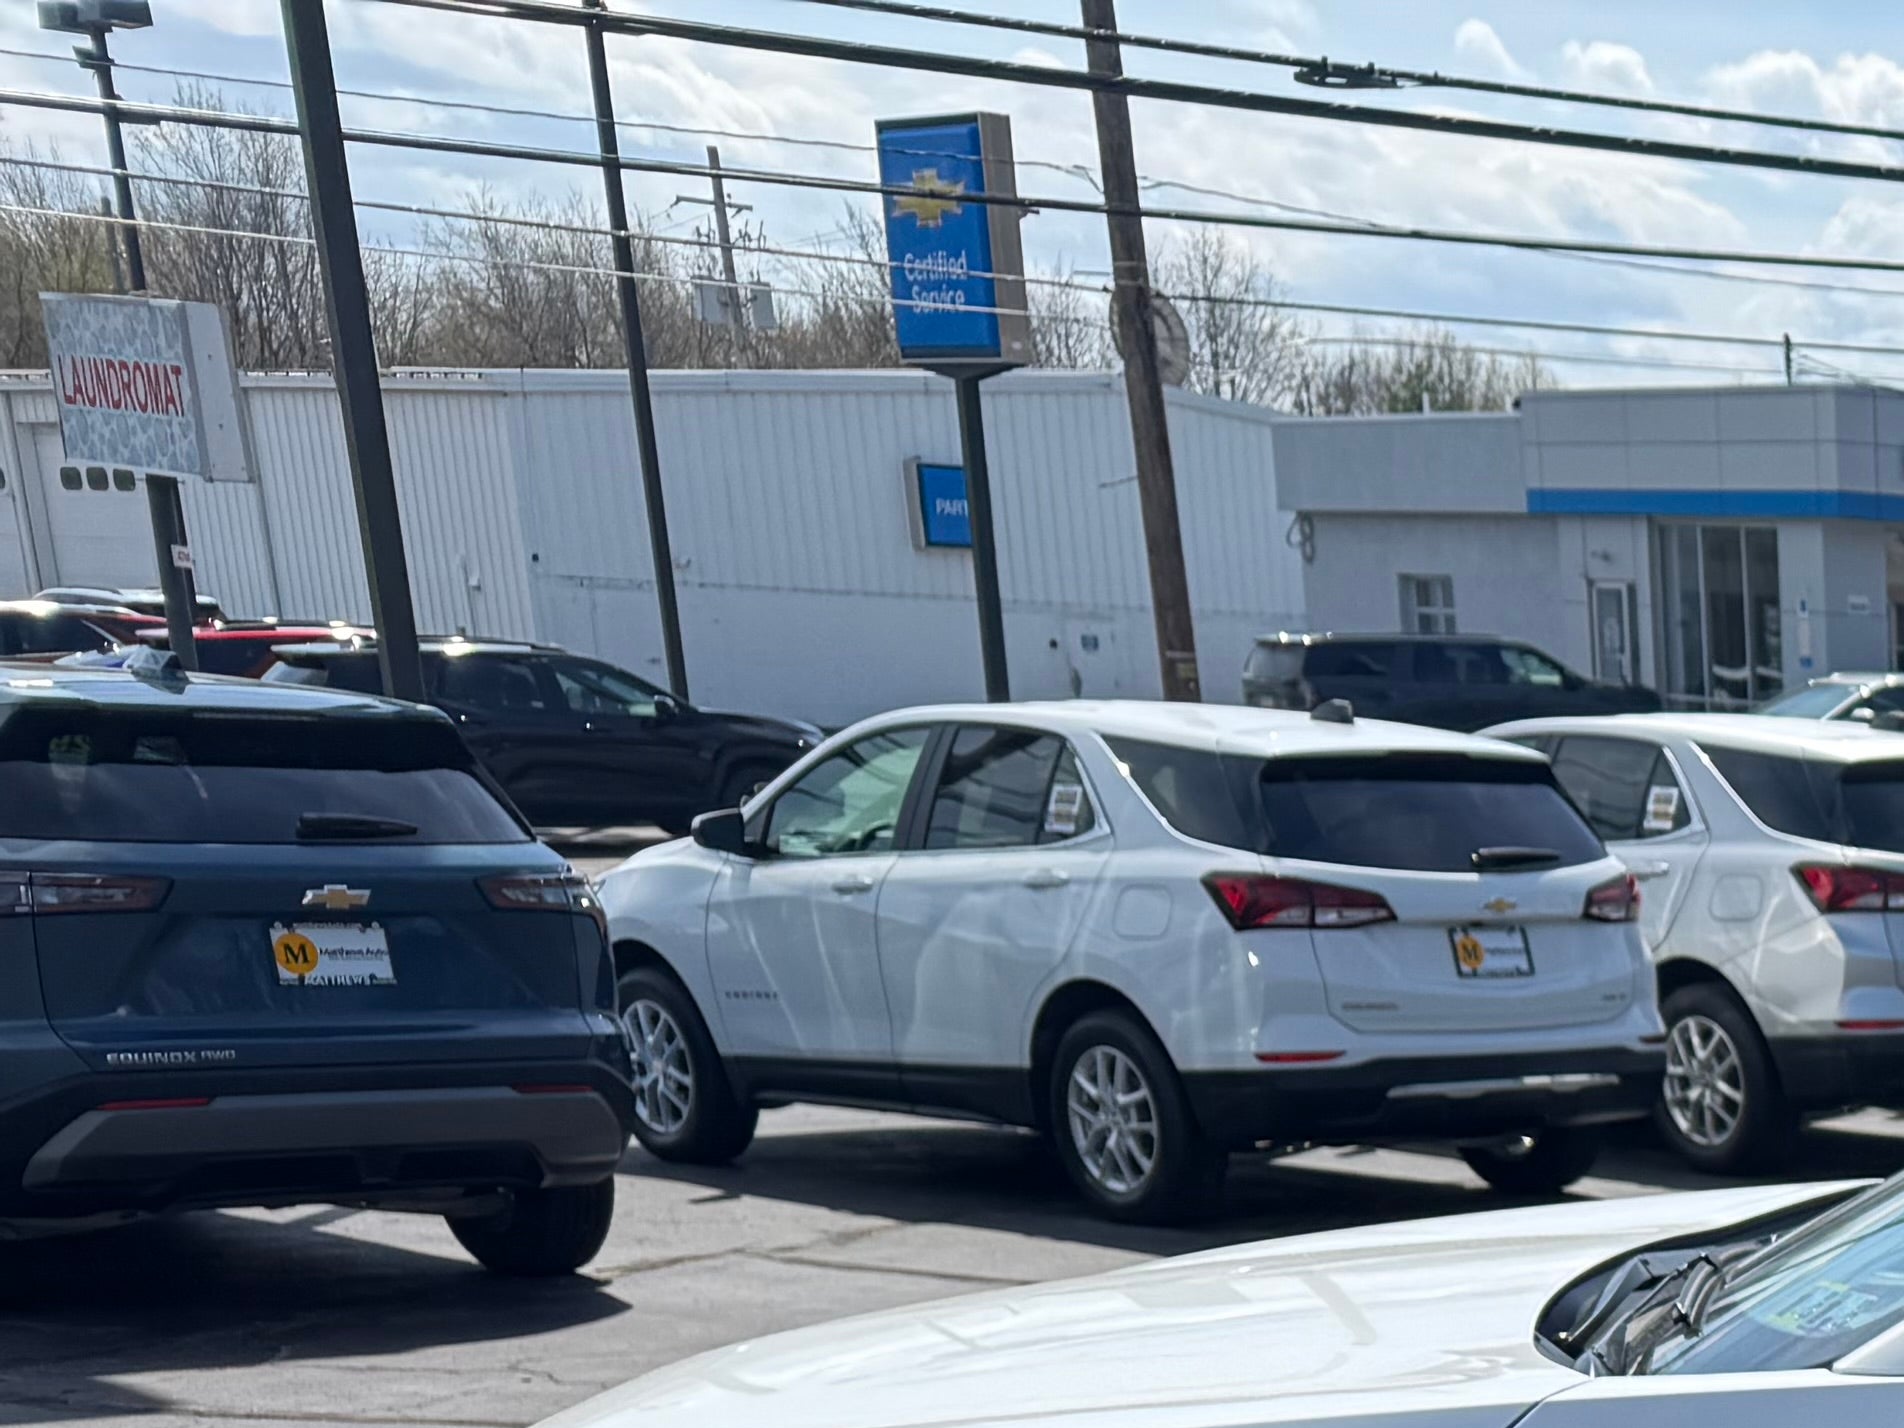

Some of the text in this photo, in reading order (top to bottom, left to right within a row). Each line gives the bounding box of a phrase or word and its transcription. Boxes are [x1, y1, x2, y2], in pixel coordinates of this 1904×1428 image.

[903, 249, 969, 282] Certified
[911, 283, 966, 314] Service
[57, 353, 185, 418] LAUNDROMAT
[283, 942, 310, 965] M
